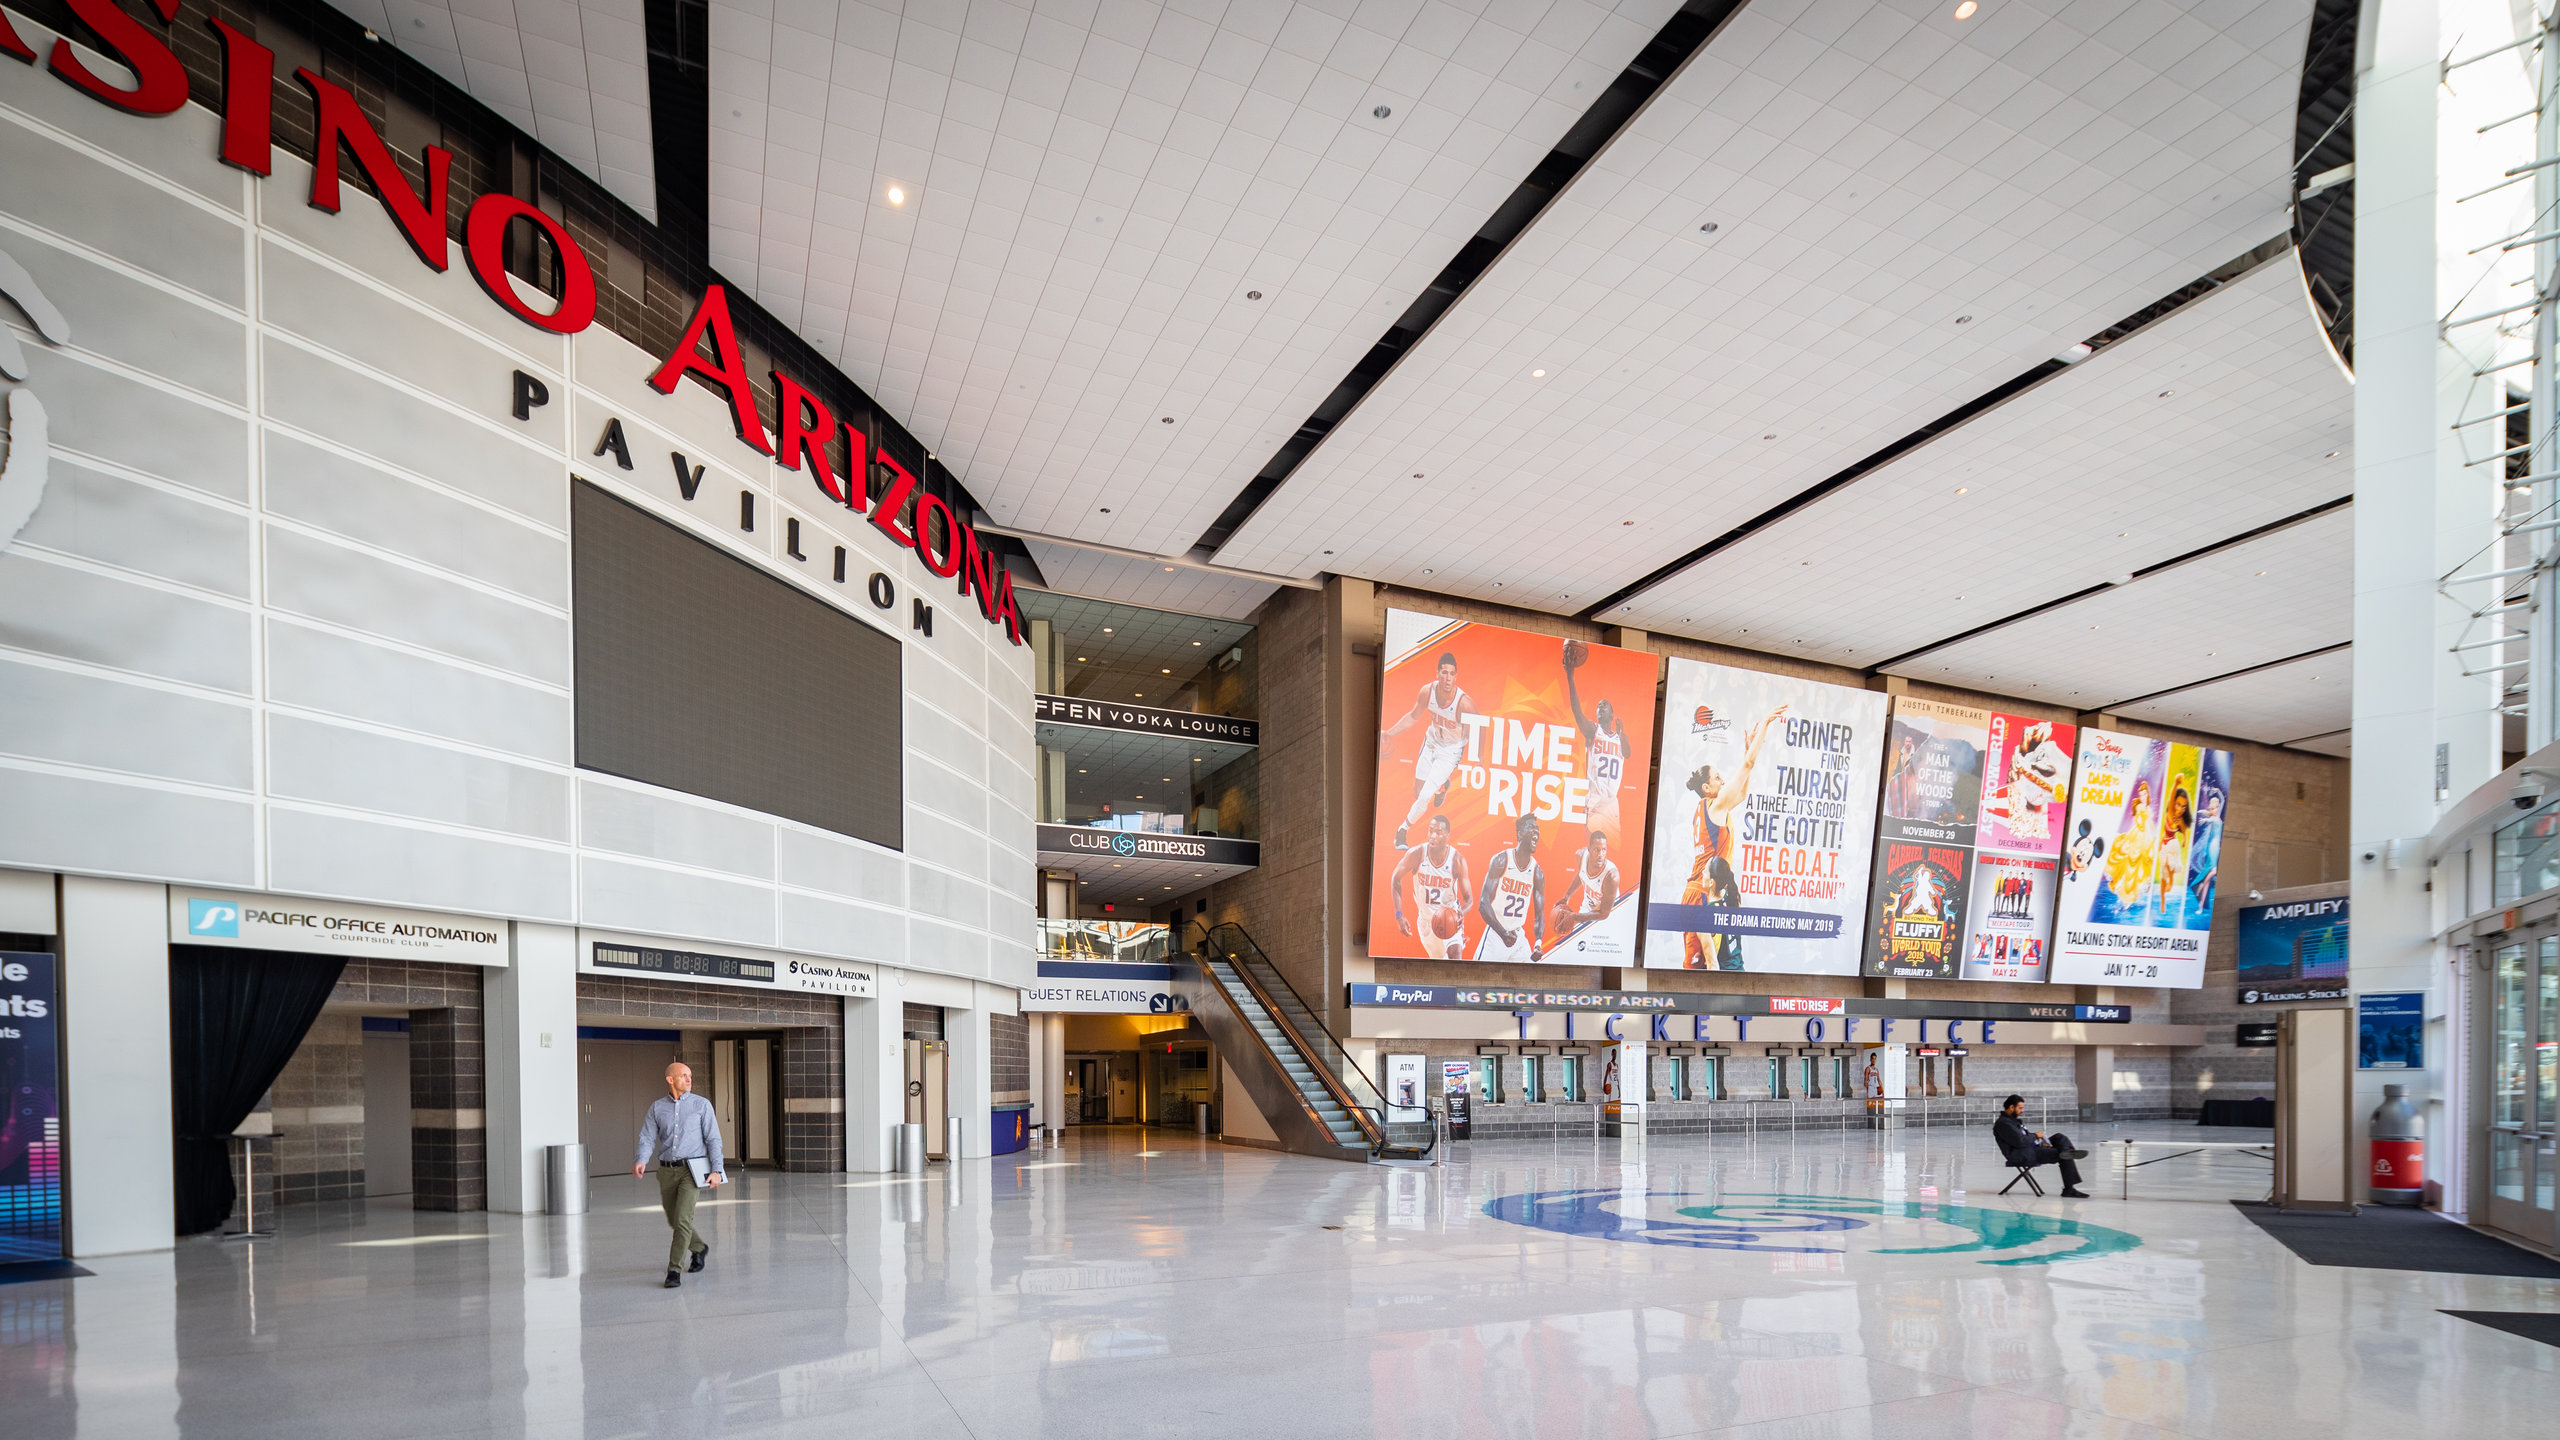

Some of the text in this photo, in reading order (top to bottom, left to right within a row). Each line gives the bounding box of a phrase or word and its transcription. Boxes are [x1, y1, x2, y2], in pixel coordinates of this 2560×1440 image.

[0, 0, 1021, 646] SINO ARIZONA
[513, 368, 933, 638] PAVILION
[1902, 700, 1983, 720] JUSTIN TIMBERLAKE
[1109, 711, 1173, 728] VODKA
[1181, 719, 1251, 737] LOUNGE
[1461, 712, 1576, 773] TIME
[2095, 736, 2122, 758] Disney
[1598, 756, 1619, 780] 20
[1820, 753, 1850, 772] FINDS
[1926, 752, 1950, 767] MAN
[1777, 765, 1849, 802] TAURASI
[1918, 768, 1953, 784] OF THE
[2088, 772, 2112, 787] DARE
[1457, 764, 1589, 824] TO RISE
[1915, 782, 1954, 799] WOODS
[2081, 787, 2123, 808] DREAM
[1746, 793, 1753, 809] A
[1815, 801, 1846, 819] GOOD!
[1743, 811, 1844, 849] SHE GOT IT!
[1902, 826, 1955, 840] NOVEMBER 29
[1069, 833, 1206, 856] CLUB annexus
[1998, 839, 2032, 849] DECEMBER
[1742, 844, 1838, 879] THE G.O.A.T.
[1887, 843, 1964, 882] GABRIEL IGLESIAS
[1995, 857, 2009, 866] KIDS
[2011, 859, 2021, 867] ON
[2022, 860, 2033, 868] THE
[1740, 874, 1797, 897] DELIVERS
[1425, 888, 1441, 905] 12
[1503, 895, 1525, 917] 22
[2263, 900, 2344, 921] AMPLIFY
[245, 908, 498, 944] PACIFIC OFFICE AUTOMATION
[1713, 912, 1834, 932] THE DRAMA RETURNS MAY 2019
[1894, 922, 1942, 938] FLUFFY
[1992, 920, 2015, 928] MIXTAPE
[331, 933, 429, 947] COURTSIDE CLUB
[1891, 939, 1942, 958] WORLD TOUR
[2067, 931, 2198, 952] TALKING STICK RESORT ARENA
[1907, 951, 1924, 959] 2019
[800, 962, 871, 981] CASINO ARIZONA
[1893, 967, 1925, 976] FEBRUARY
[1992, 968, 2018, 977] MAY 22
[2104, 963, 2123, 976] JAN
[2125, 965, 2136, 976] 17
[2146, 966, 2158, 978] 20
[802, 980, 865, 993] PAVILION
[1028, 989, 1147, 1003] GUEST RELATIONS
[2261, 992, 2306, 1001] TALKING
[2308, 989, 2339, 999] STICK
[1392, 989, 1433, 1004] PayPal
[1485, 992, 1539, 1005] STICK
[1544, 994, 1613, 1007] RESORT
[1619, 996, 1675, 1008] ARENA
[1772, 999, 1829, 1012] TIME TO RISE
[2095, 1009, 2119, 1020] PayPal
[1512, 1011, 1996, 1044] TICKET OFFICE
